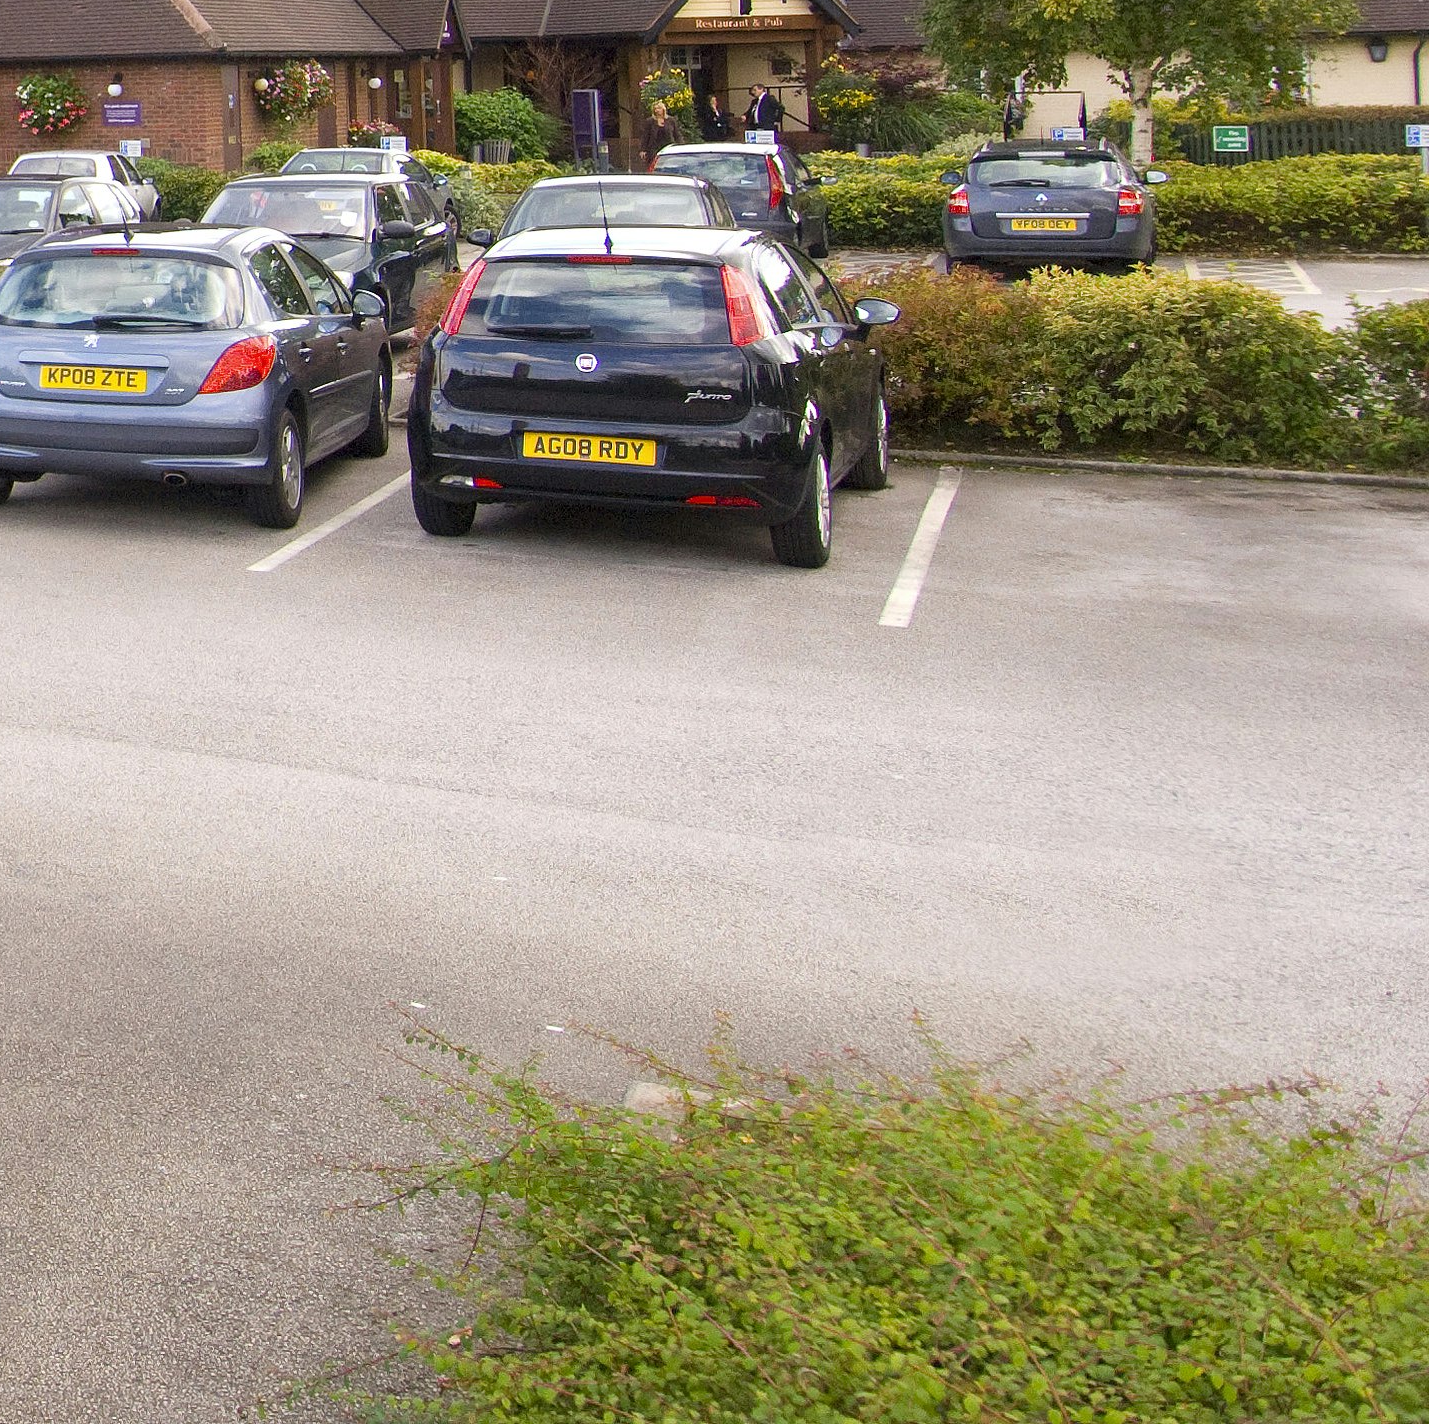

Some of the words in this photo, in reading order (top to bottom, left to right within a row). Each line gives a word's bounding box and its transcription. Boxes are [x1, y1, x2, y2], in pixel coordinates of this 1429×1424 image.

[695, 19, 749, 29] Restaurant
[752, 18, 761, 27] &
[764, 17, 783, 27] Pub
[47, 367, 96, 385] KP08
[101, 369, 139, 388] ZTE
[533, 436, 592, 456] AG08
[599, 440, 645, 461] RDY
